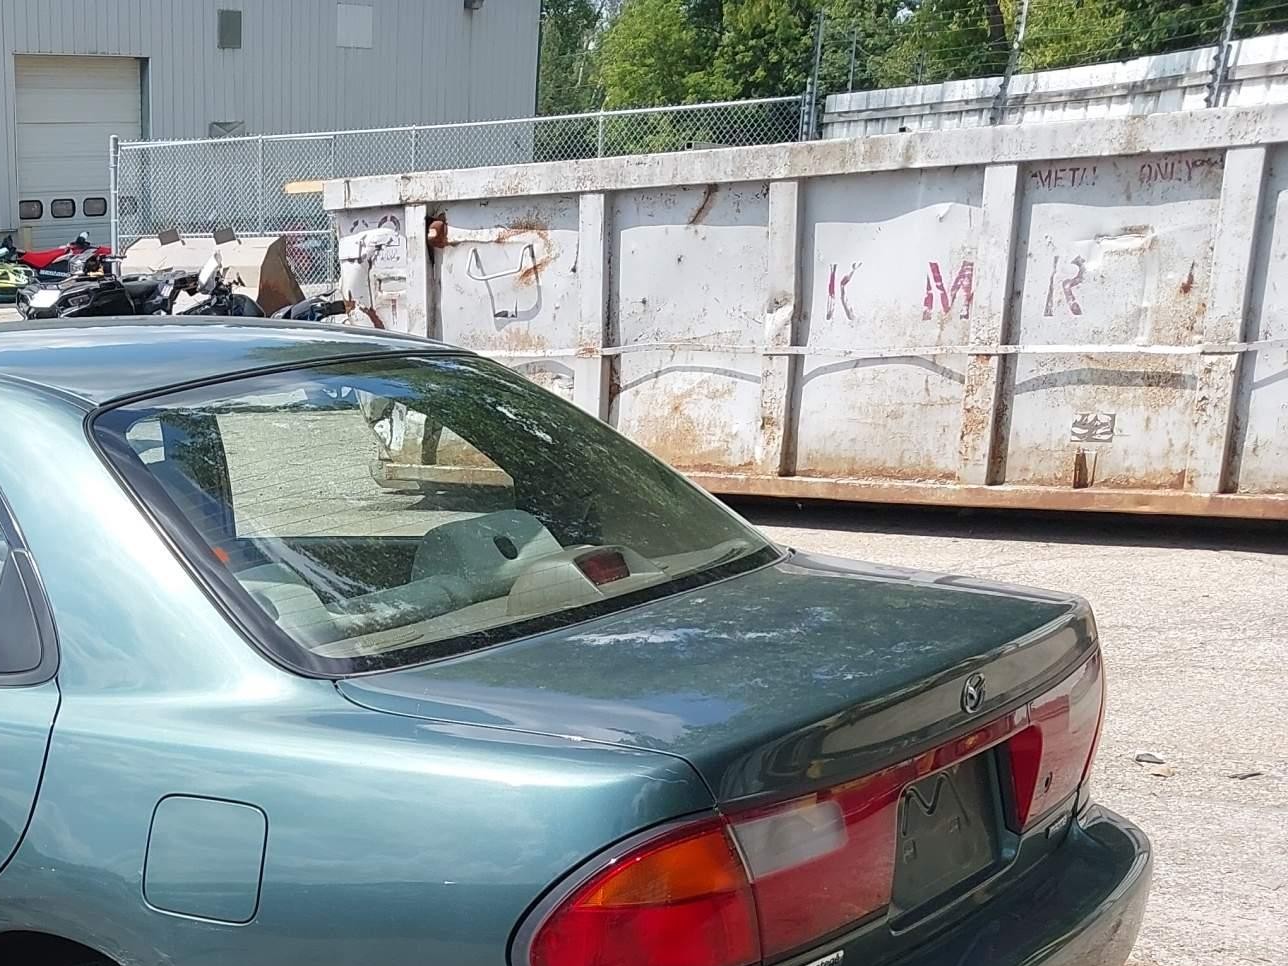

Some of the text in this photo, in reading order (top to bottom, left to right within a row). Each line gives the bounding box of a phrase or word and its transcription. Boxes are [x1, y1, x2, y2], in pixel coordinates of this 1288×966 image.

[1139, 158, 1194, 184] ONLY
[826, 255, 1086, 321] K M R
